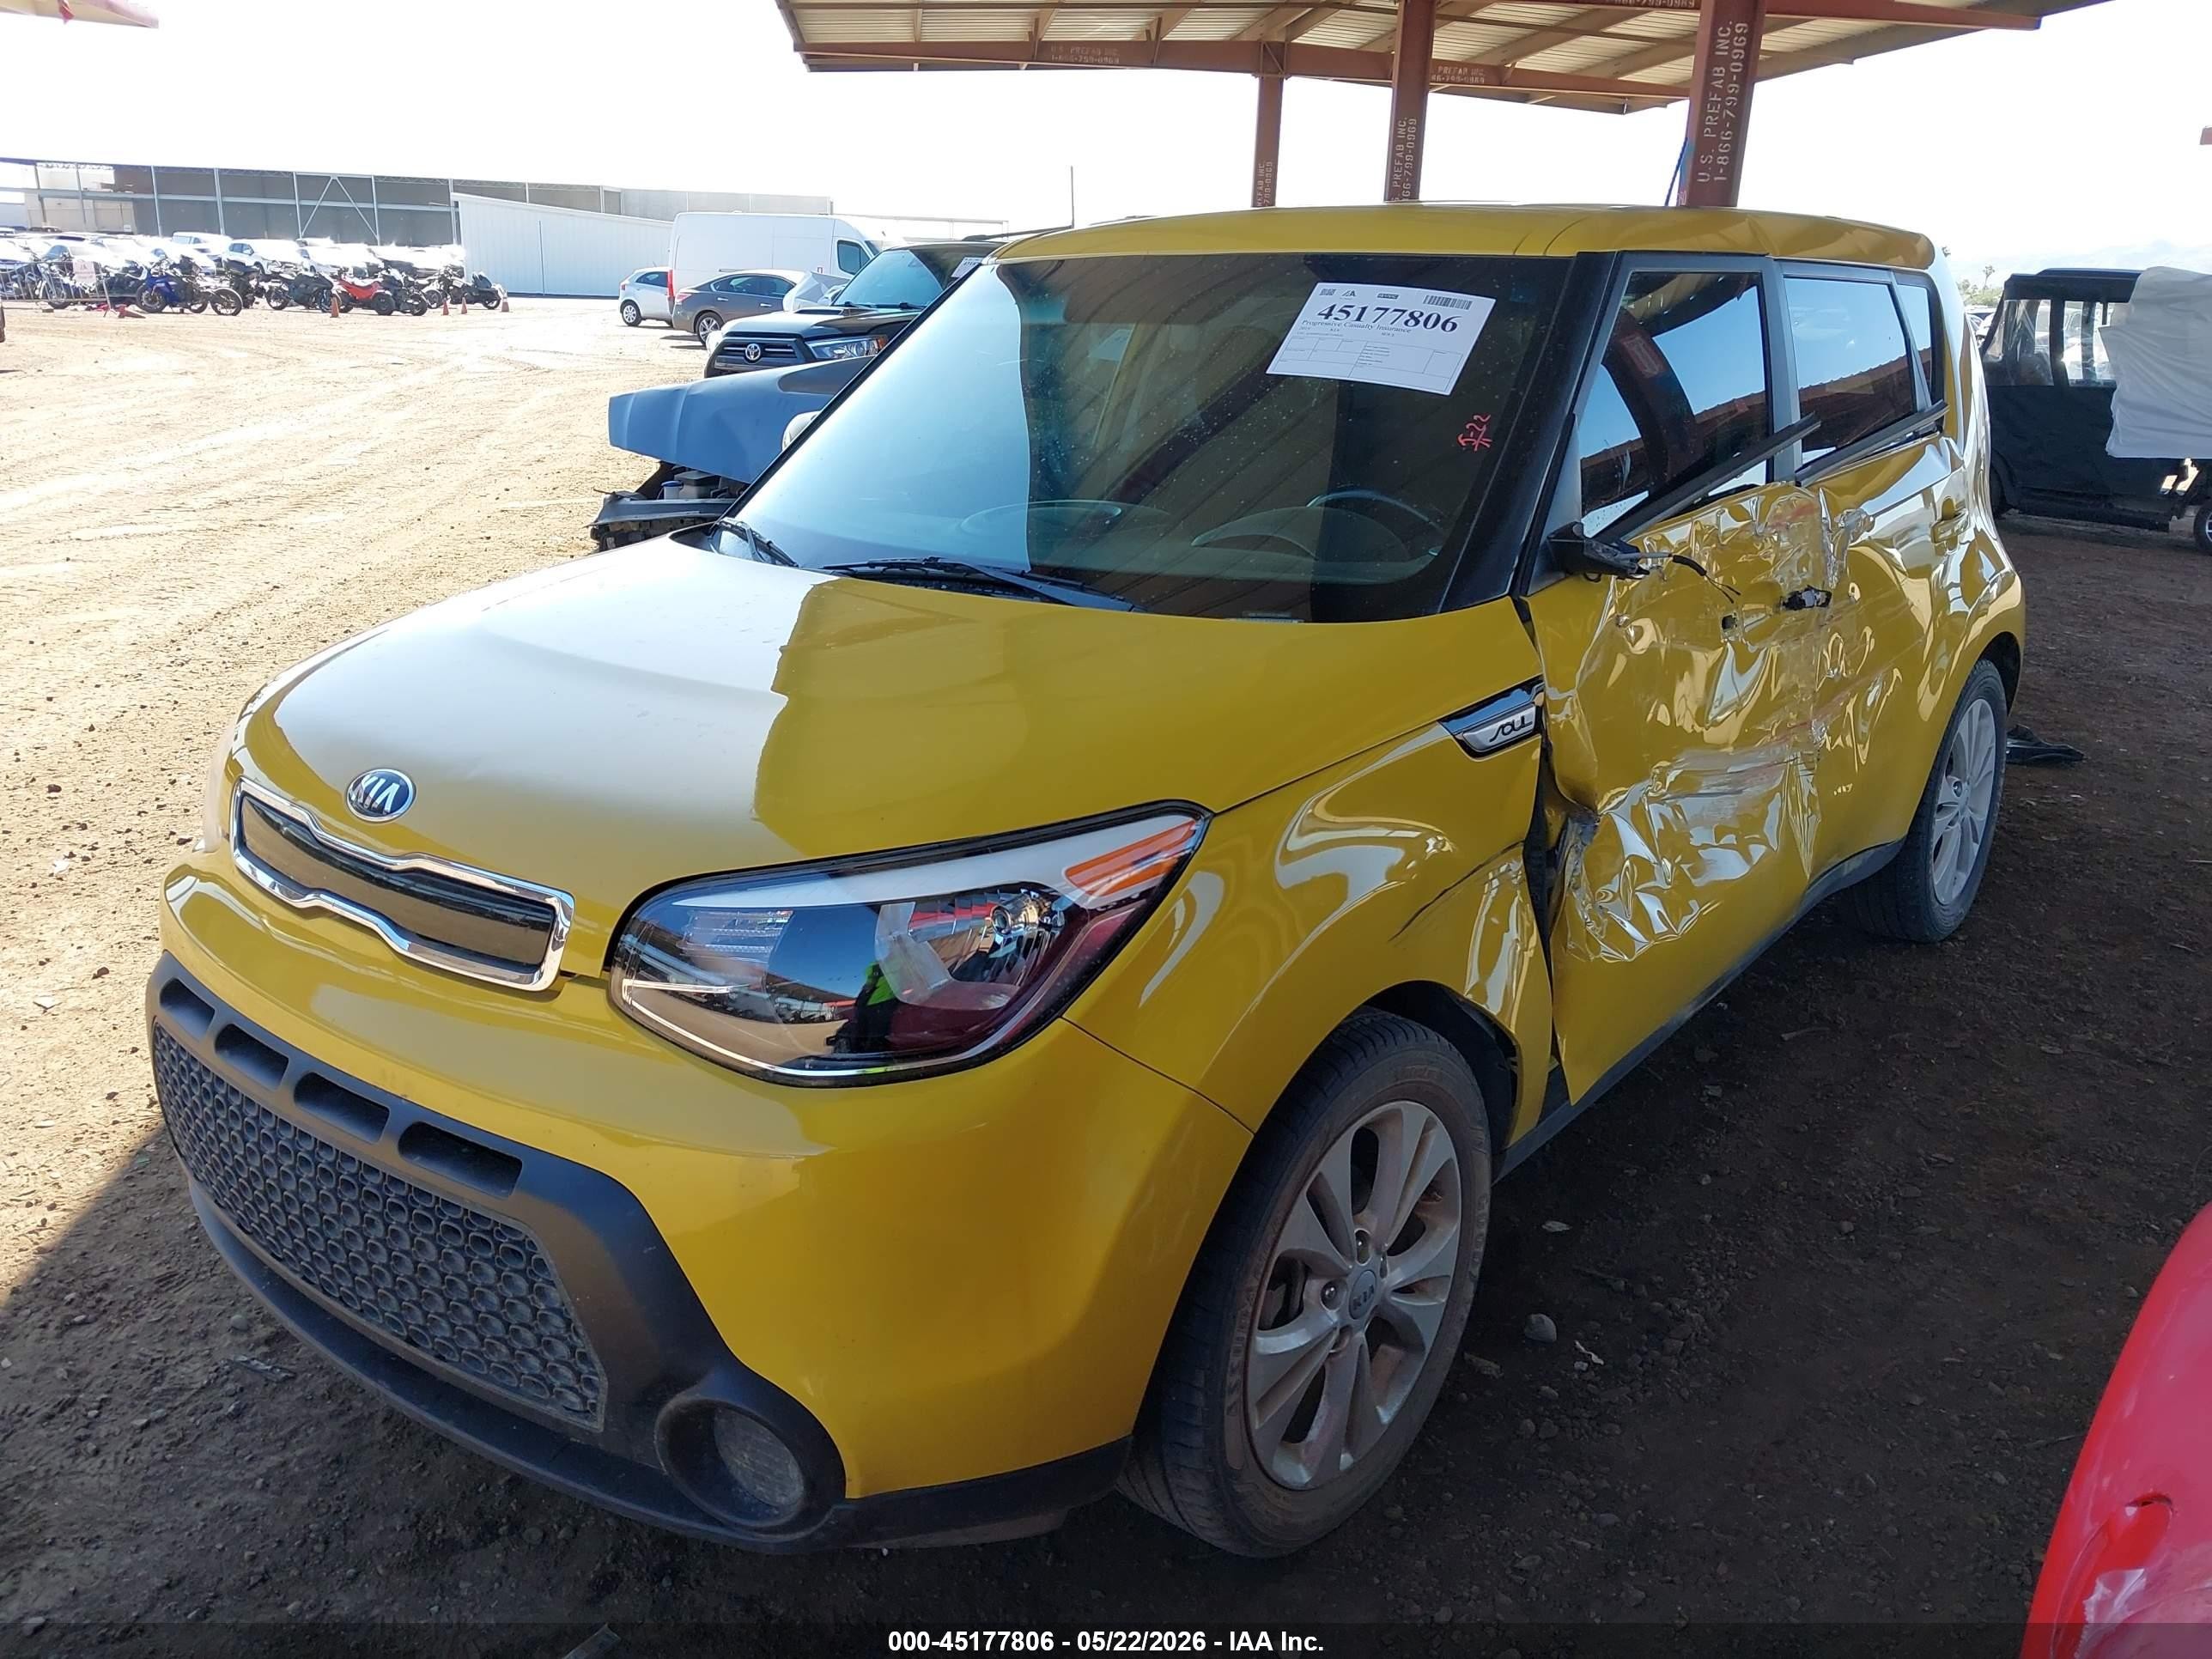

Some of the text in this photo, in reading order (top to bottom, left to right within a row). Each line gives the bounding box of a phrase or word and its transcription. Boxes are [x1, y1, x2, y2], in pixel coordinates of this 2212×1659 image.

[1698, 21, 1734, 183] U.S. PREFAB INC.
[1714, 22, 1749, 182] 1-866-799-0969
[1397, 117, 1408, 138] INC.
[1392, 144, 1404, 187] PREFAB
[1317, 303, 1462, 333] 45177806
[1343, 322, 1374, 331] Casualty
[1376, 325, 1413, 333] Insurance
[349, 772, 402, 815] KIA
